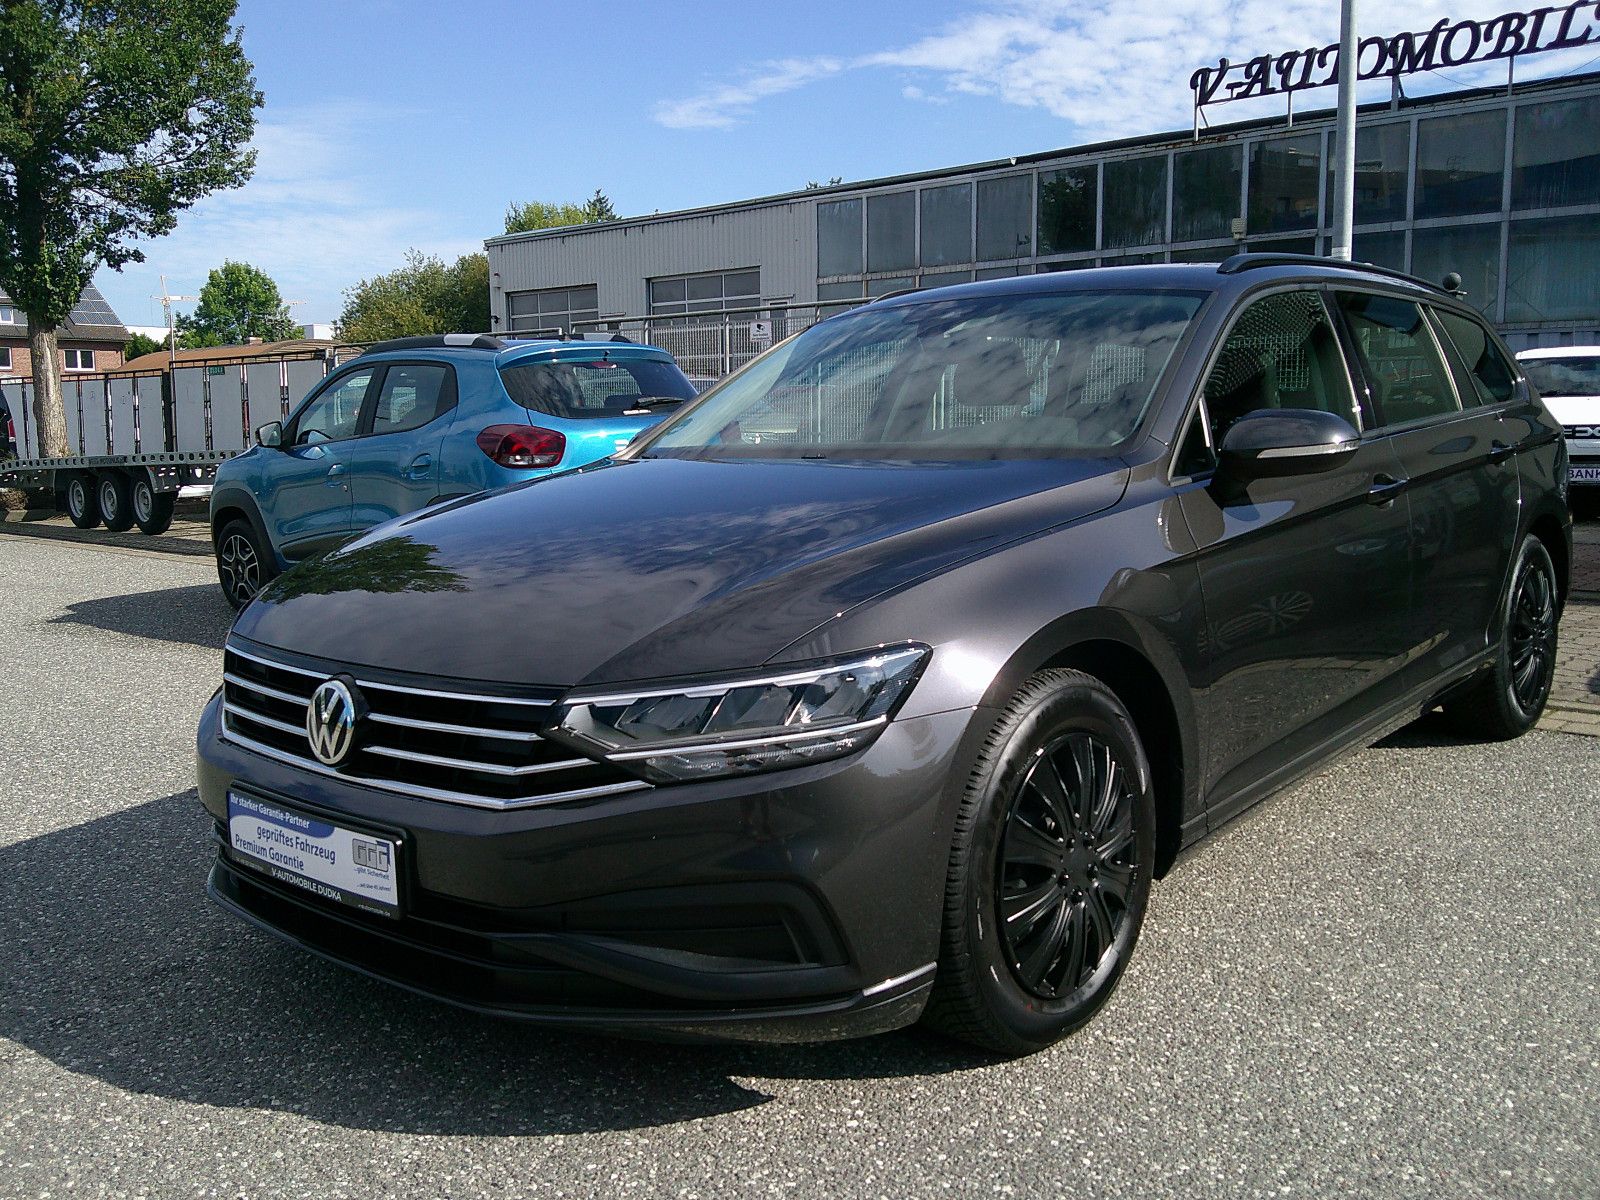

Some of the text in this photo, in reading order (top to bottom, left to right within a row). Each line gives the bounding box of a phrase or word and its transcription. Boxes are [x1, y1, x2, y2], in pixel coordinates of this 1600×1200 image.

[1189, 0, 1600, 106] V-AUTOMOBIL
[239, 797, 258, 811] starker
[258, 803, 310, 829] Garantie-Partner
[235, 834, 268, 858] Premium
[269, 847, 304, 871] Garantie
[256, 825, 336, 865] geprüftes Fahrzeug
[318, 884, 342, 902] DUDKA
